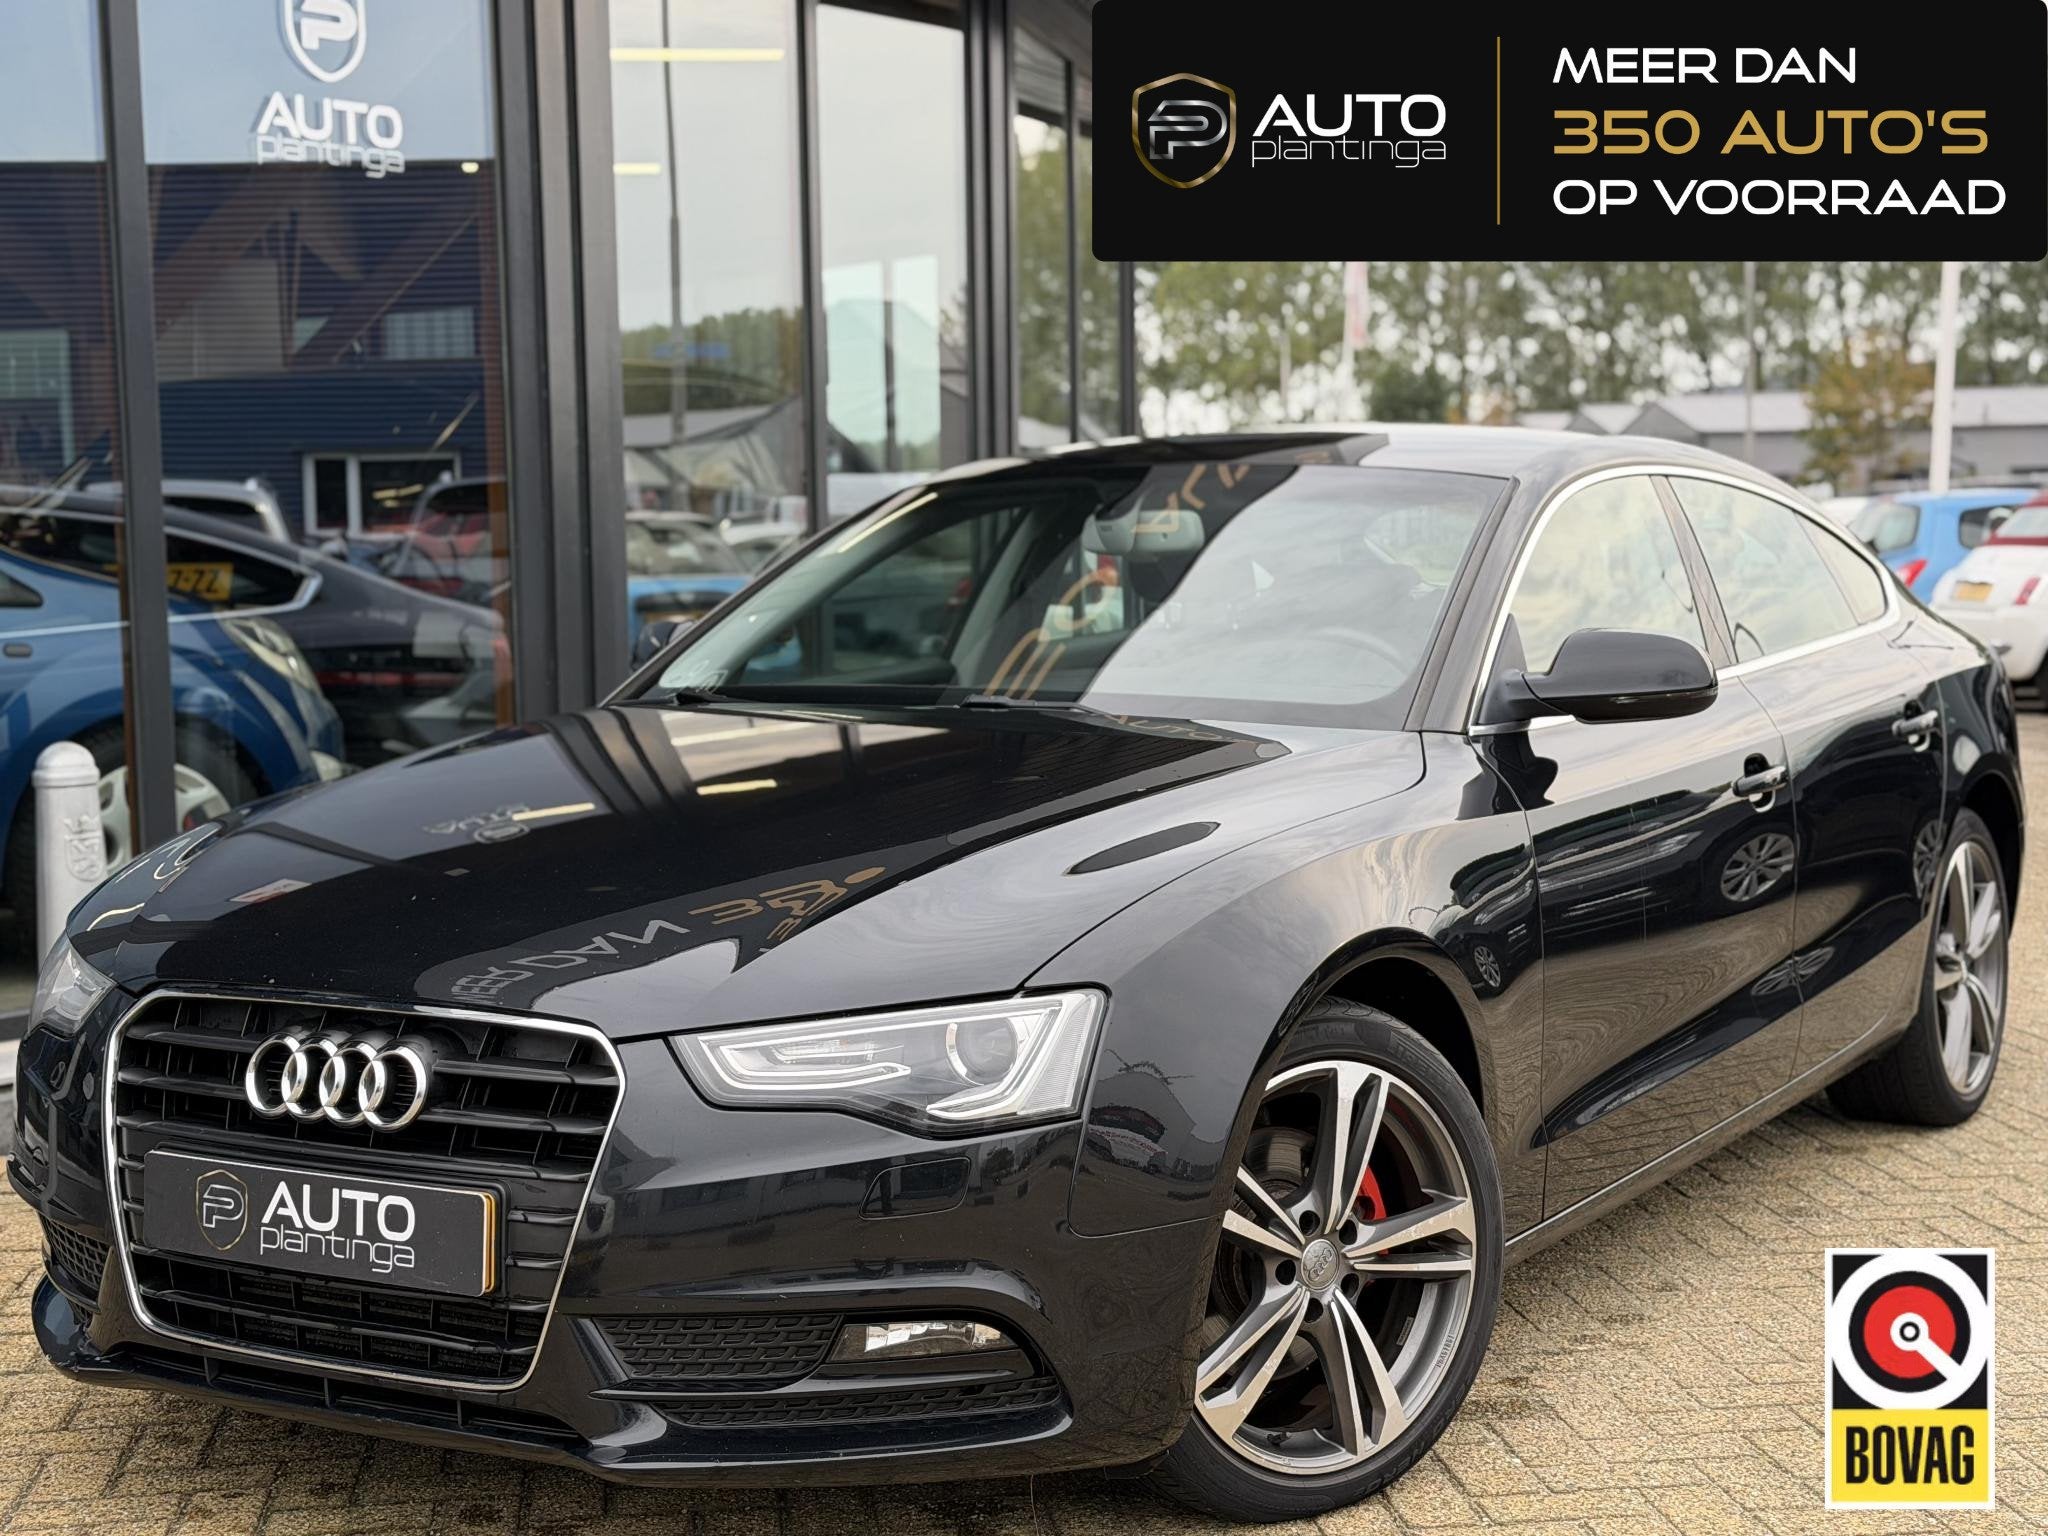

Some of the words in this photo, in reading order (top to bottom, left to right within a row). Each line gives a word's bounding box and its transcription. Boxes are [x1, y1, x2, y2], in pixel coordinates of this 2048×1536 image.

[257, 91, 403, 149] AUTO
[257, 132, 405, 178] plantinga
[261, 1181, 415, 1242] AUTO
[260, 1223, 415, 1273] plantinga
